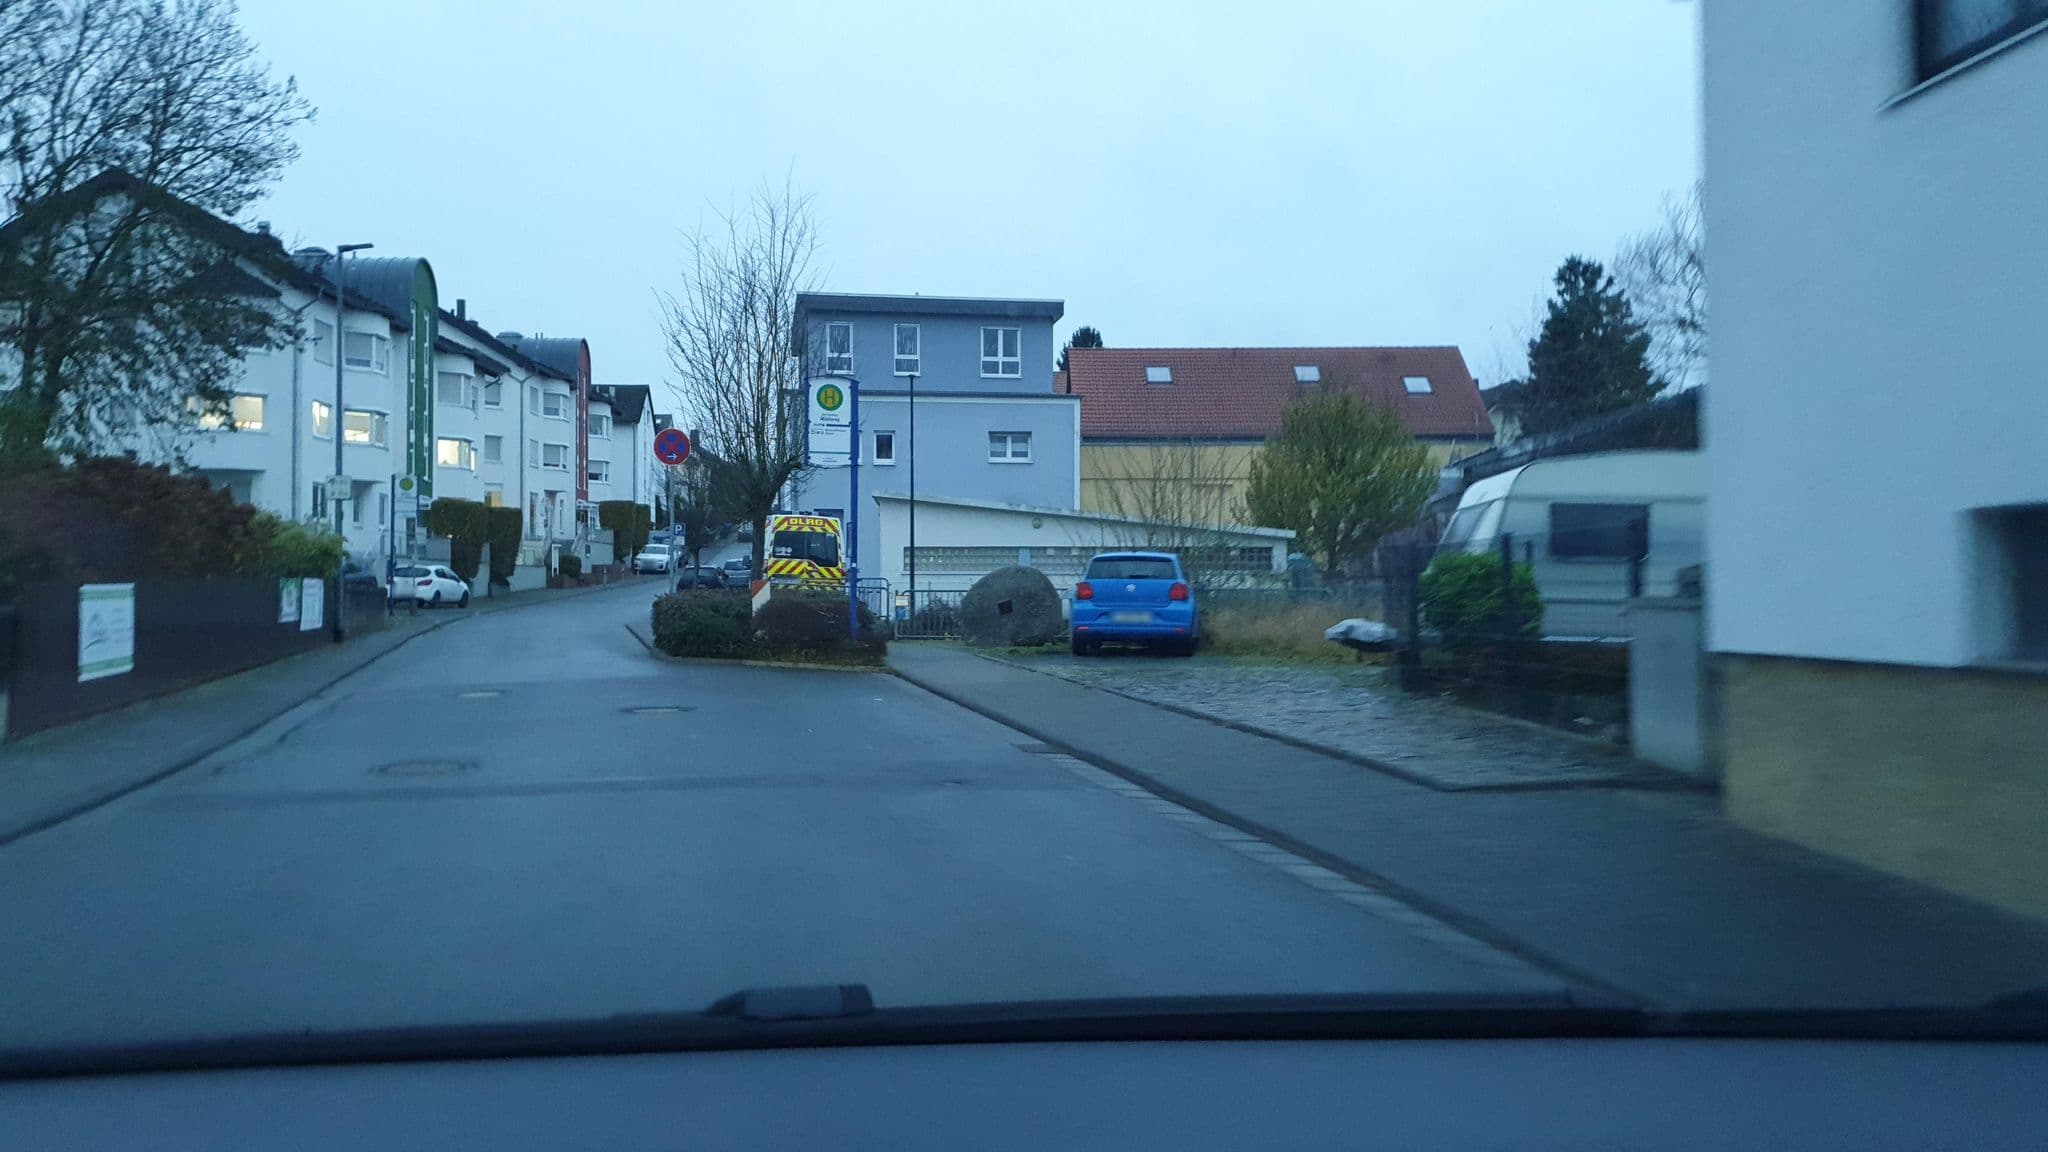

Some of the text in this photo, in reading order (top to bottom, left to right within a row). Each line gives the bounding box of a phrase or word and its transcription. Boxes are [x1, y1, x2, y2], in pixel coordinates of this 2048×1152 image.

[824, 390, 835, 405] H
[789, 518, 824, 526] DLRG
[675, 524, 683, 535] P
